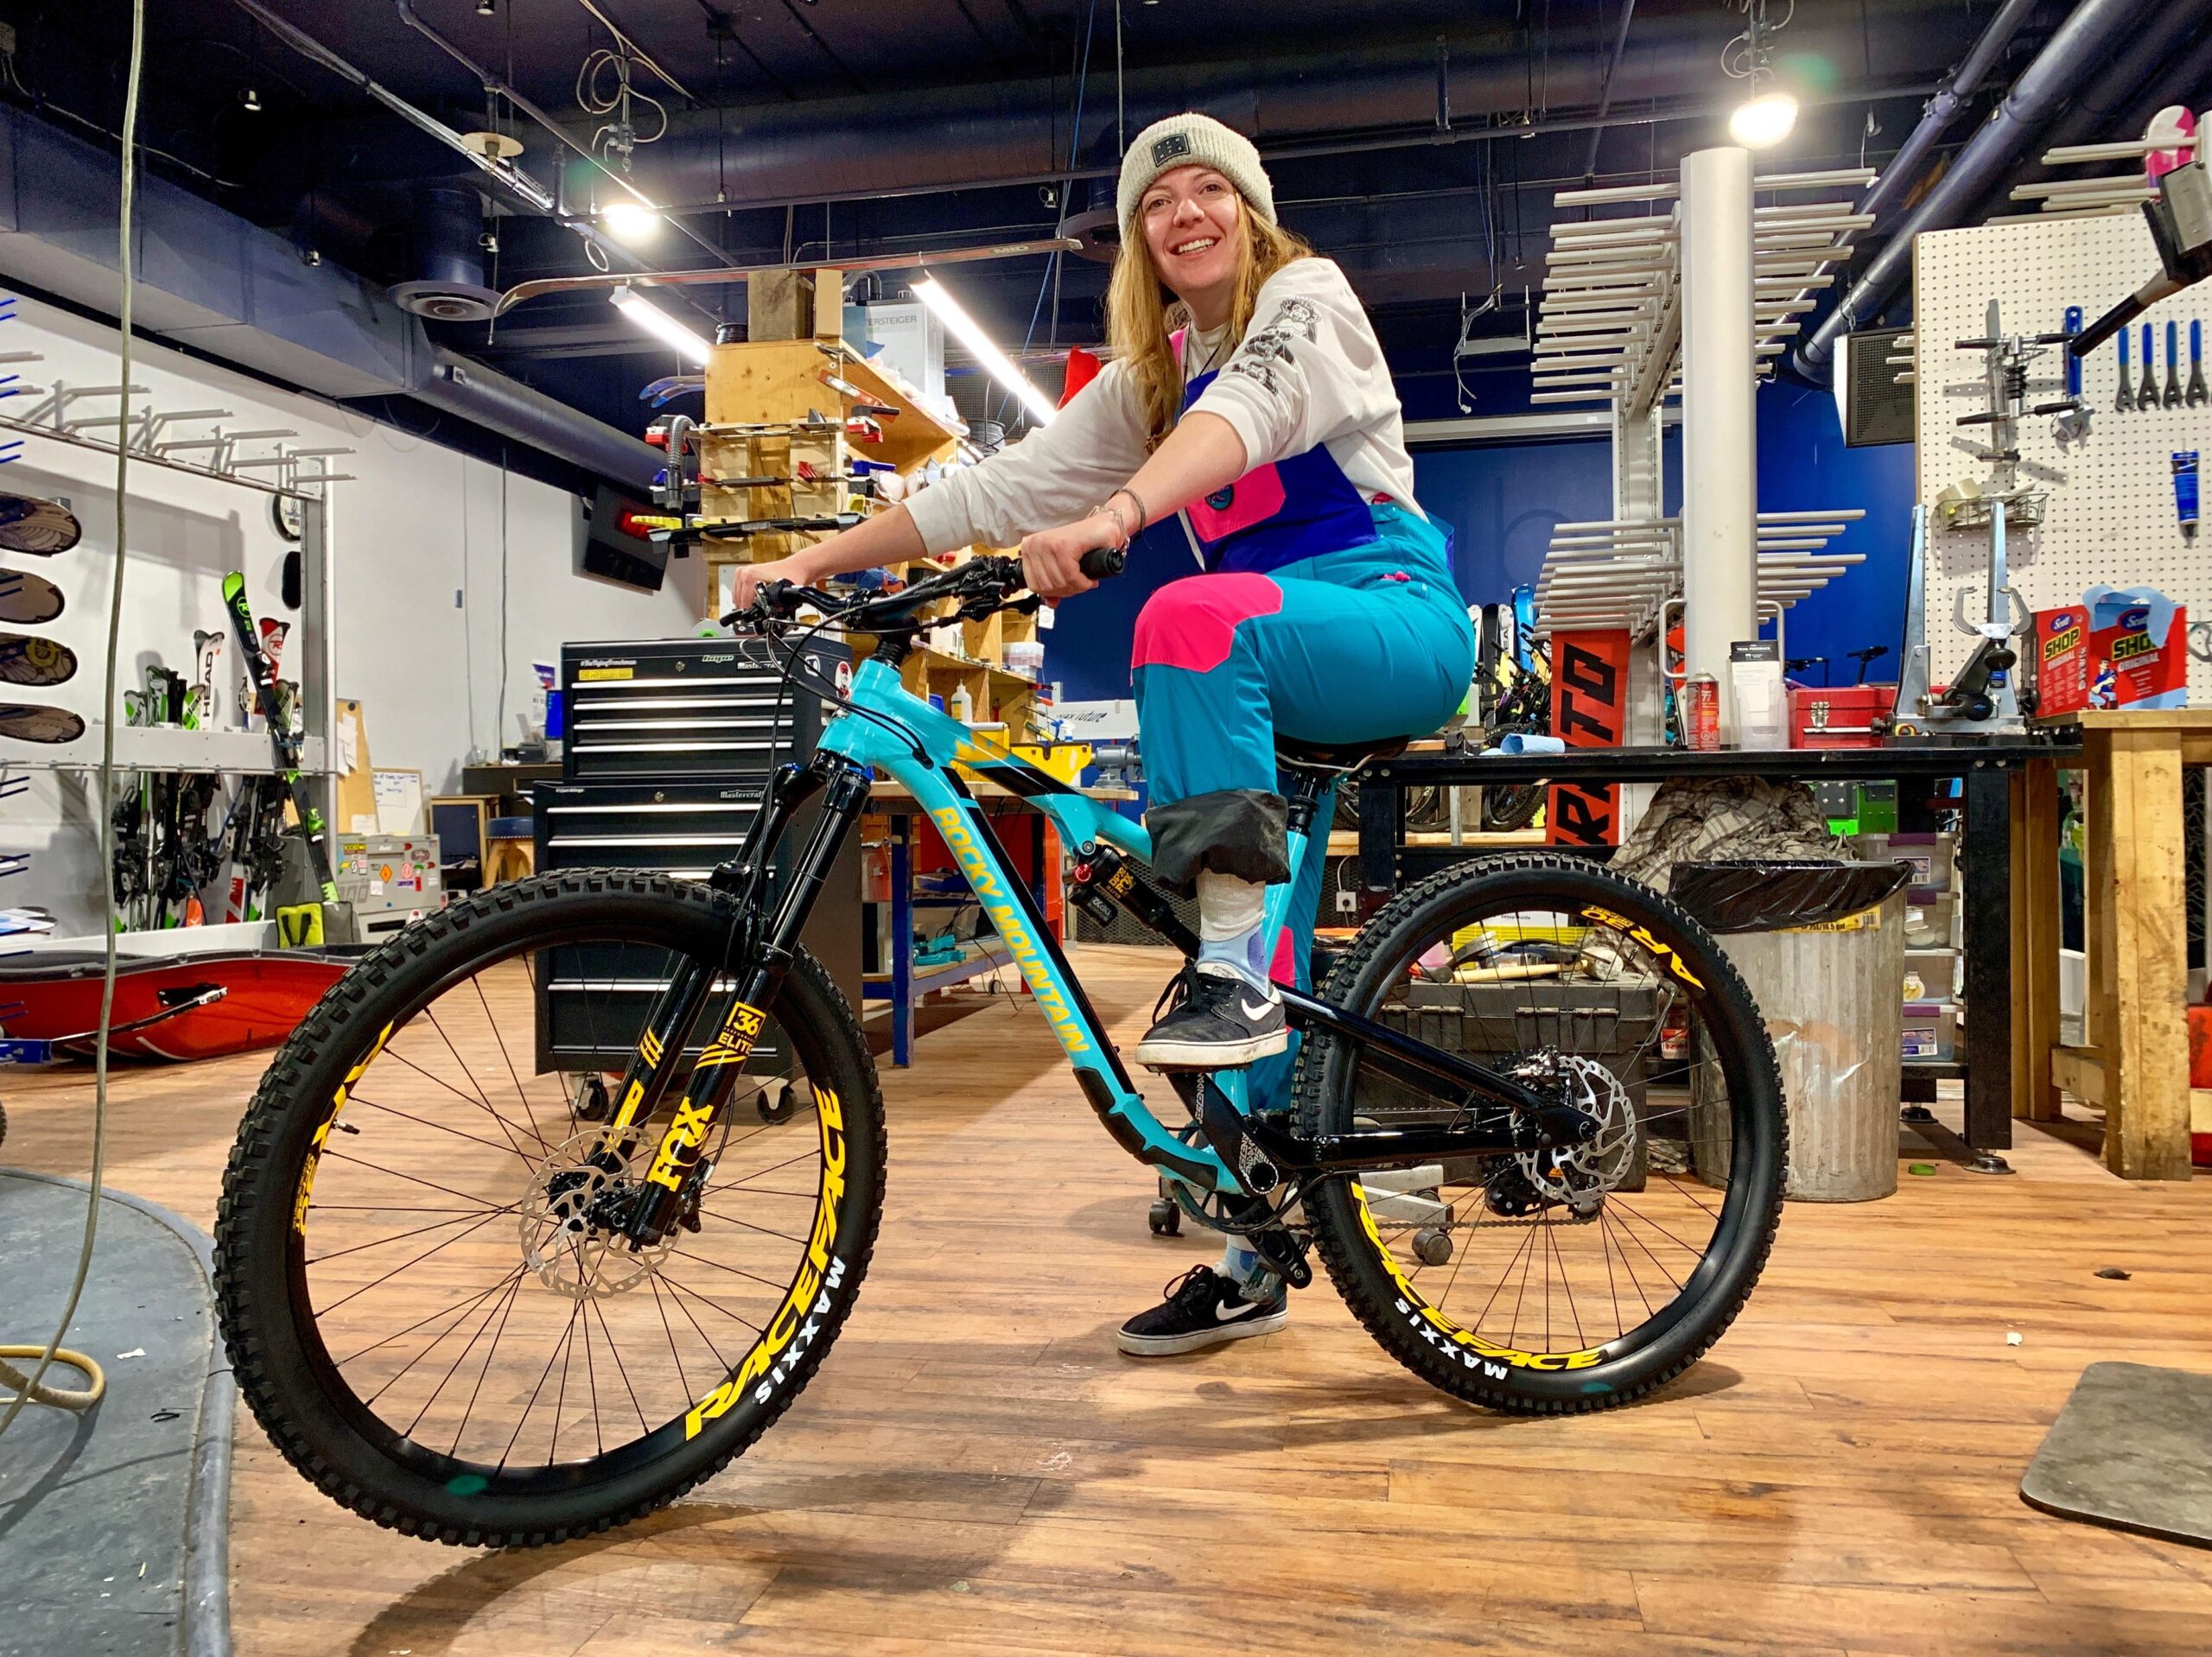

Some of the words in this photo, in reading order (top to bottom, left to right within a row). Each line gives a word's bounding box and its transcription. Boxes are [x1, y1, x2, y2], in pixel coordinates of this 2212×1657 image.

[2044, 627, 2080, 660] SHOP
[2113, 632, 2158, 660] SHO
[203, 651, 213, 717] HEAD
[1700, 694, 1712, 702] 77
[932, 807, 1003, 898] ROCKY
[990, 905, 1090, 1052] MOUNTAIN
[718, 1032, 755, 1055] ELITE
[733, 1009, 760, 1036] 36
[646, 1095, 718, 1193] FOX
[755, 1254, 846, 1406] MAXXIS
[1395, 1298, 1509, 1381] MAXXIS
